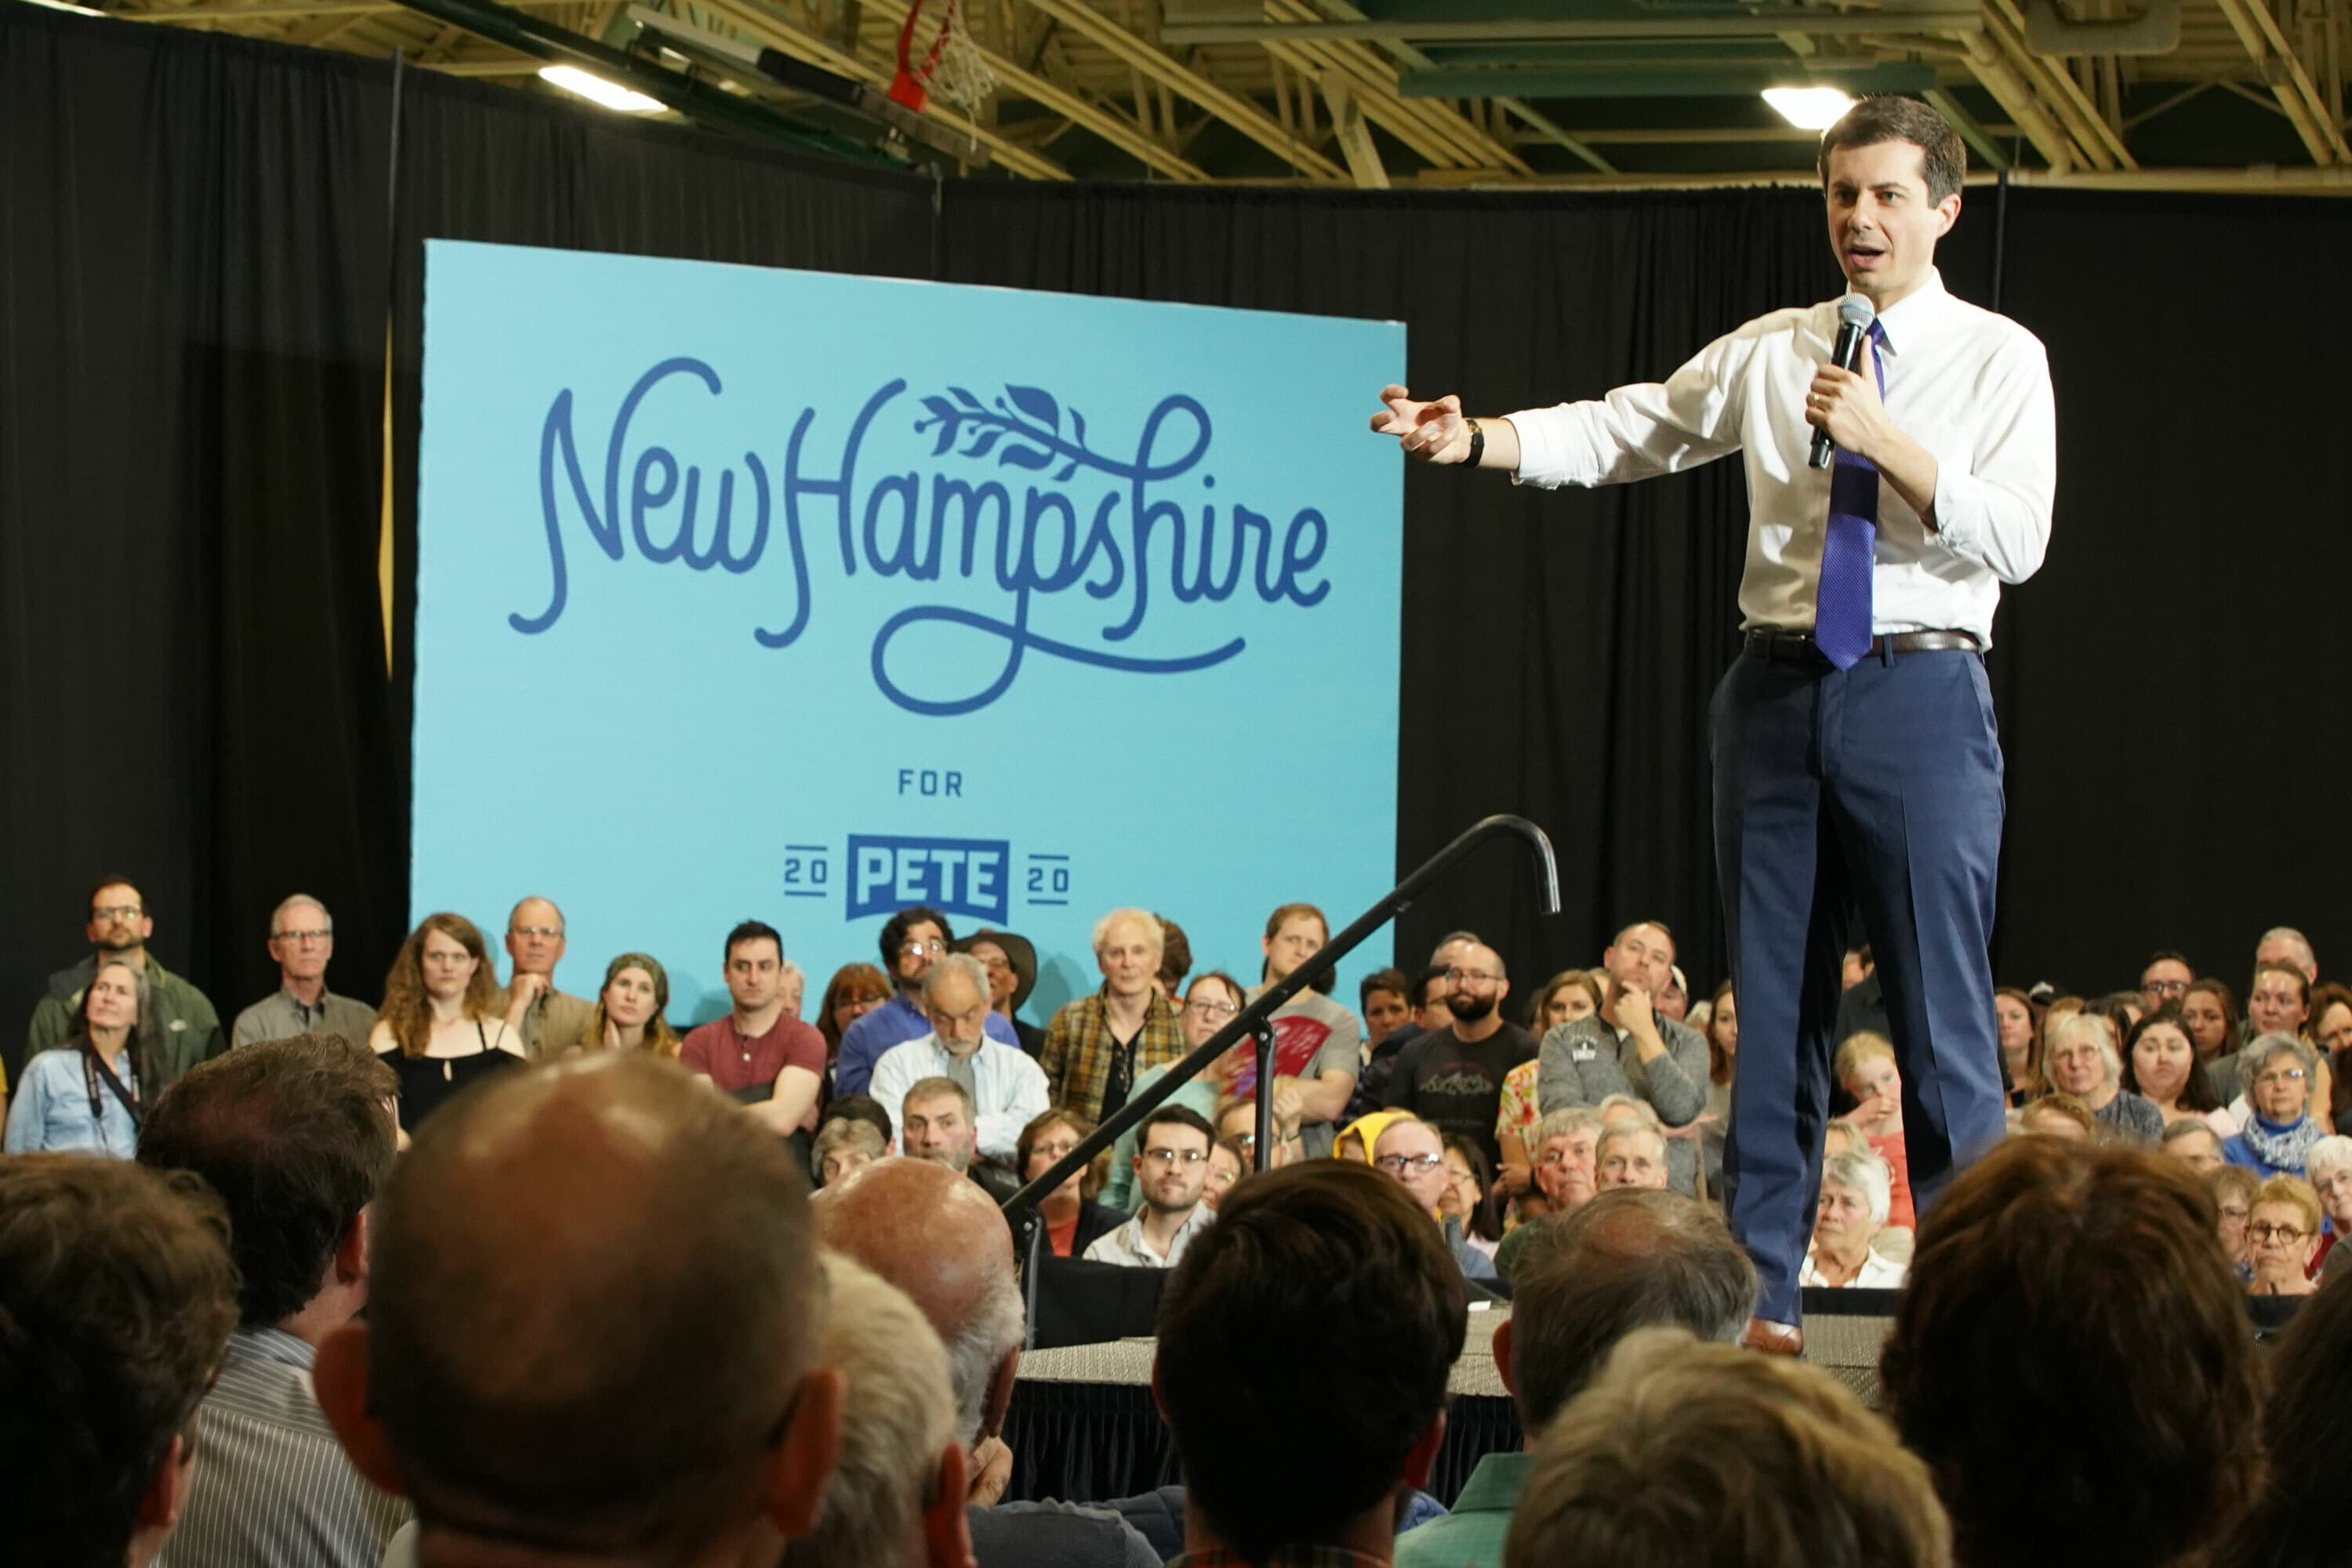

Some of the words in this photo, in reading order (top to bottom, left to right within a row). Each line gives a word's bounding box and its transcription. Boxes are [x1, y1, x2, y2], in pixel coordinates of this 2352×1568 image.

[509, 358, 771, 634] New
[754, 377, 1332, 717] Hampshire
[898, 769, 963, 797] FOR
[785, 858, 827, 884] 20
[856, 846, 1000, 909] PETE
[1027, 867, 1069, 892] 20
